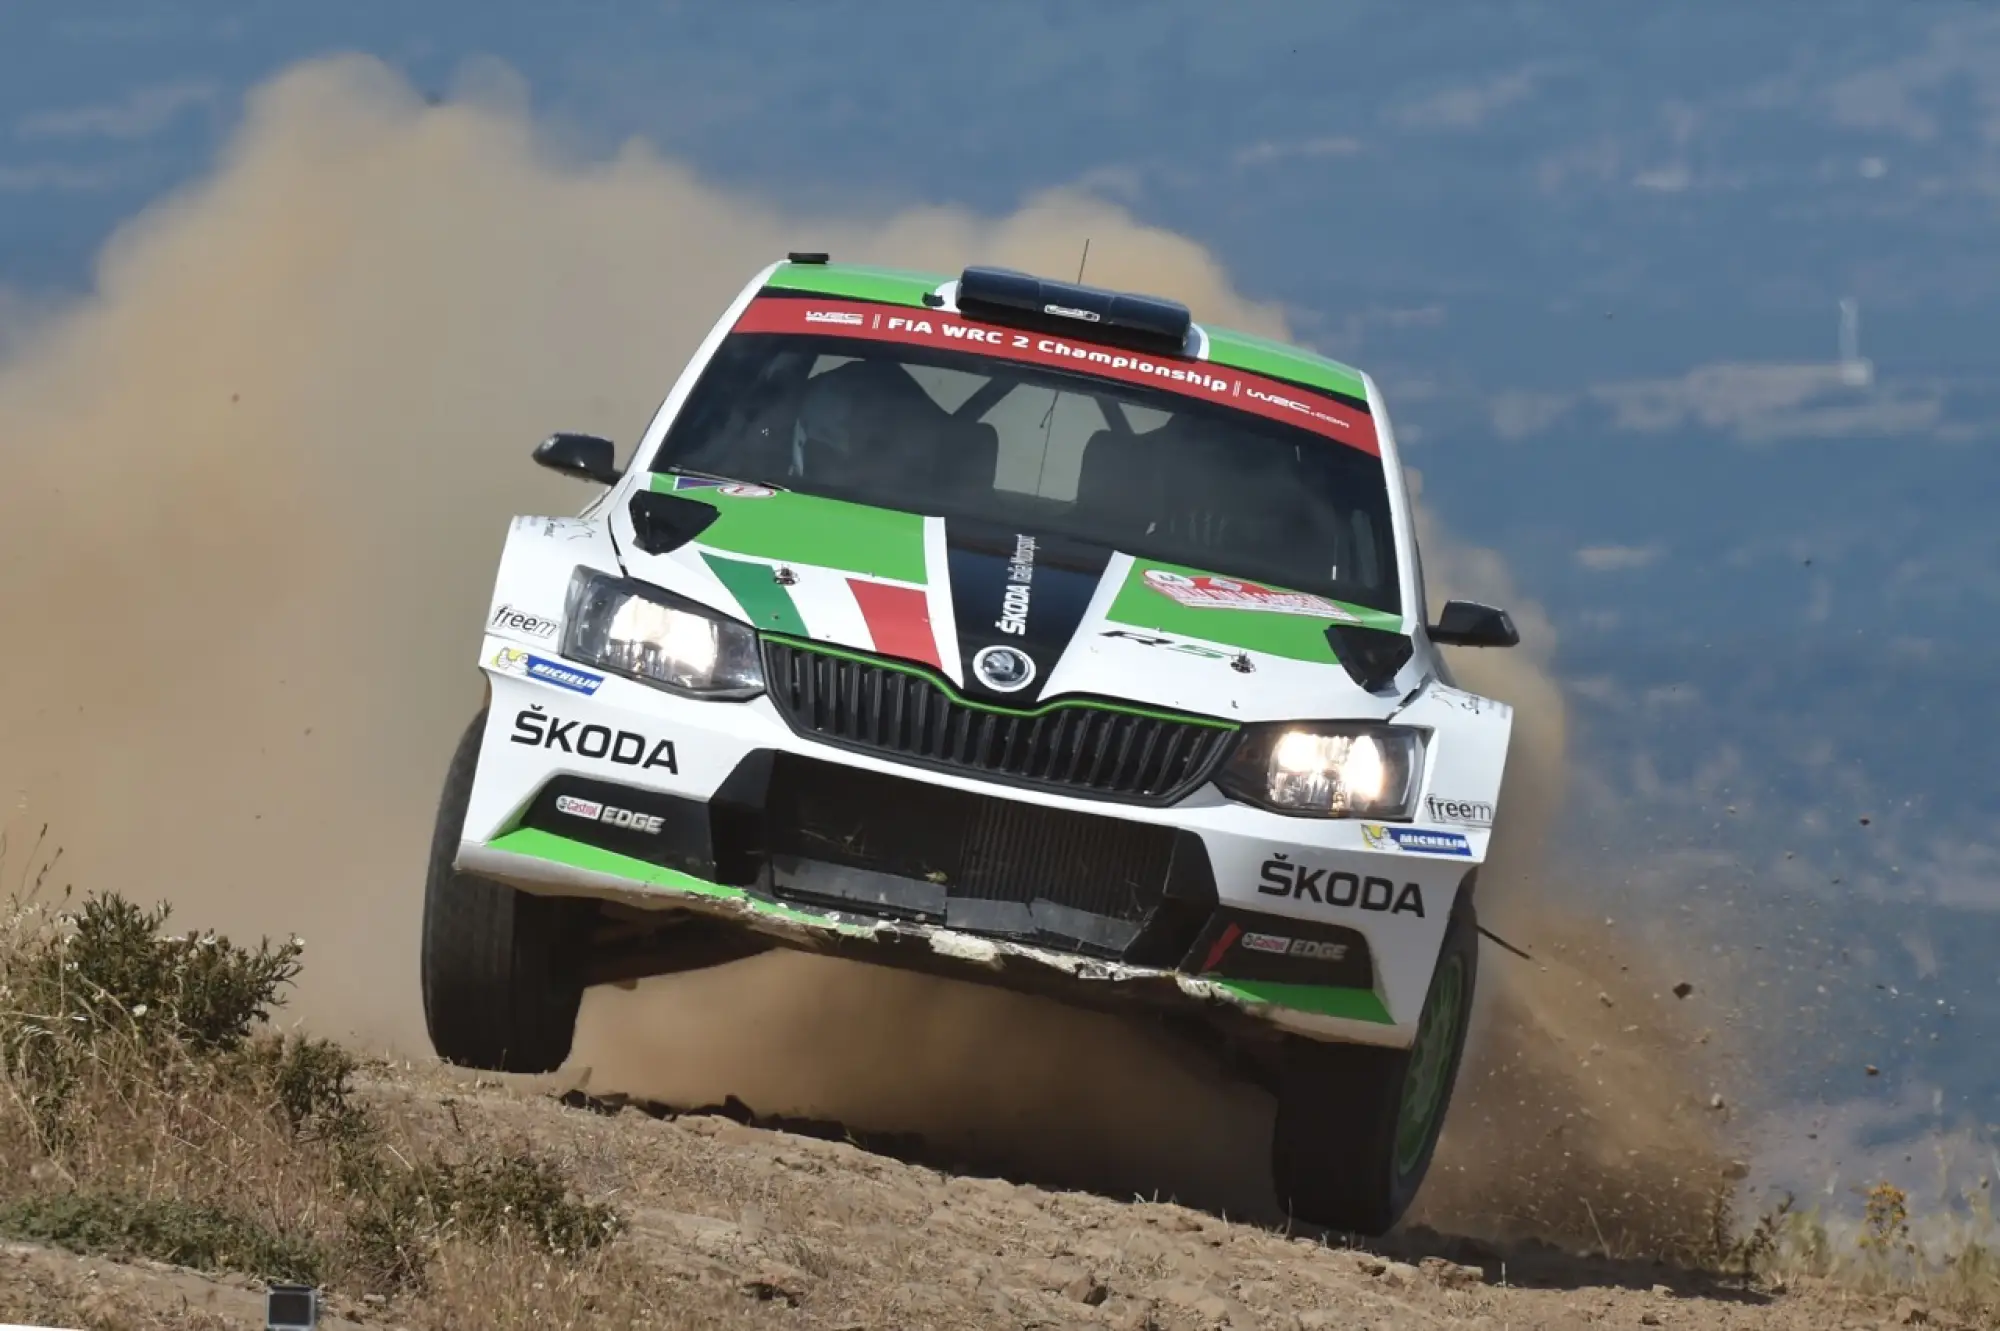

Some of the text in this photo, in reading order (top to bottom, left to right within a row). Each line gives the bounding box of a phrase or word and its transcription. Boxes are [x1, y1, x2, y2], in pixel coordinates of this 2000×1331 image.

[888, 317, 933, 334] FIA
[941, 323, 1004, 345] WRC
[1011, 335, 1030, 349] 2
[1037, 339, 1228, 392] Championship
[491, 603, 558, 640] freem
[994, 584, 1031, 636] ŠKODA
[530, 662, 602, 690] MICHELIN
[510, 704, 679, 775] ŠKODA
[600, 806, 667, 835] EDGE
[1425, 794, 1492, 823] freem
[1399, 833, 1467, 848] MICHELIN
[1258, 853, 1425, 918] ŠKODA
[1289, 939, 1349, 960] EDGE
